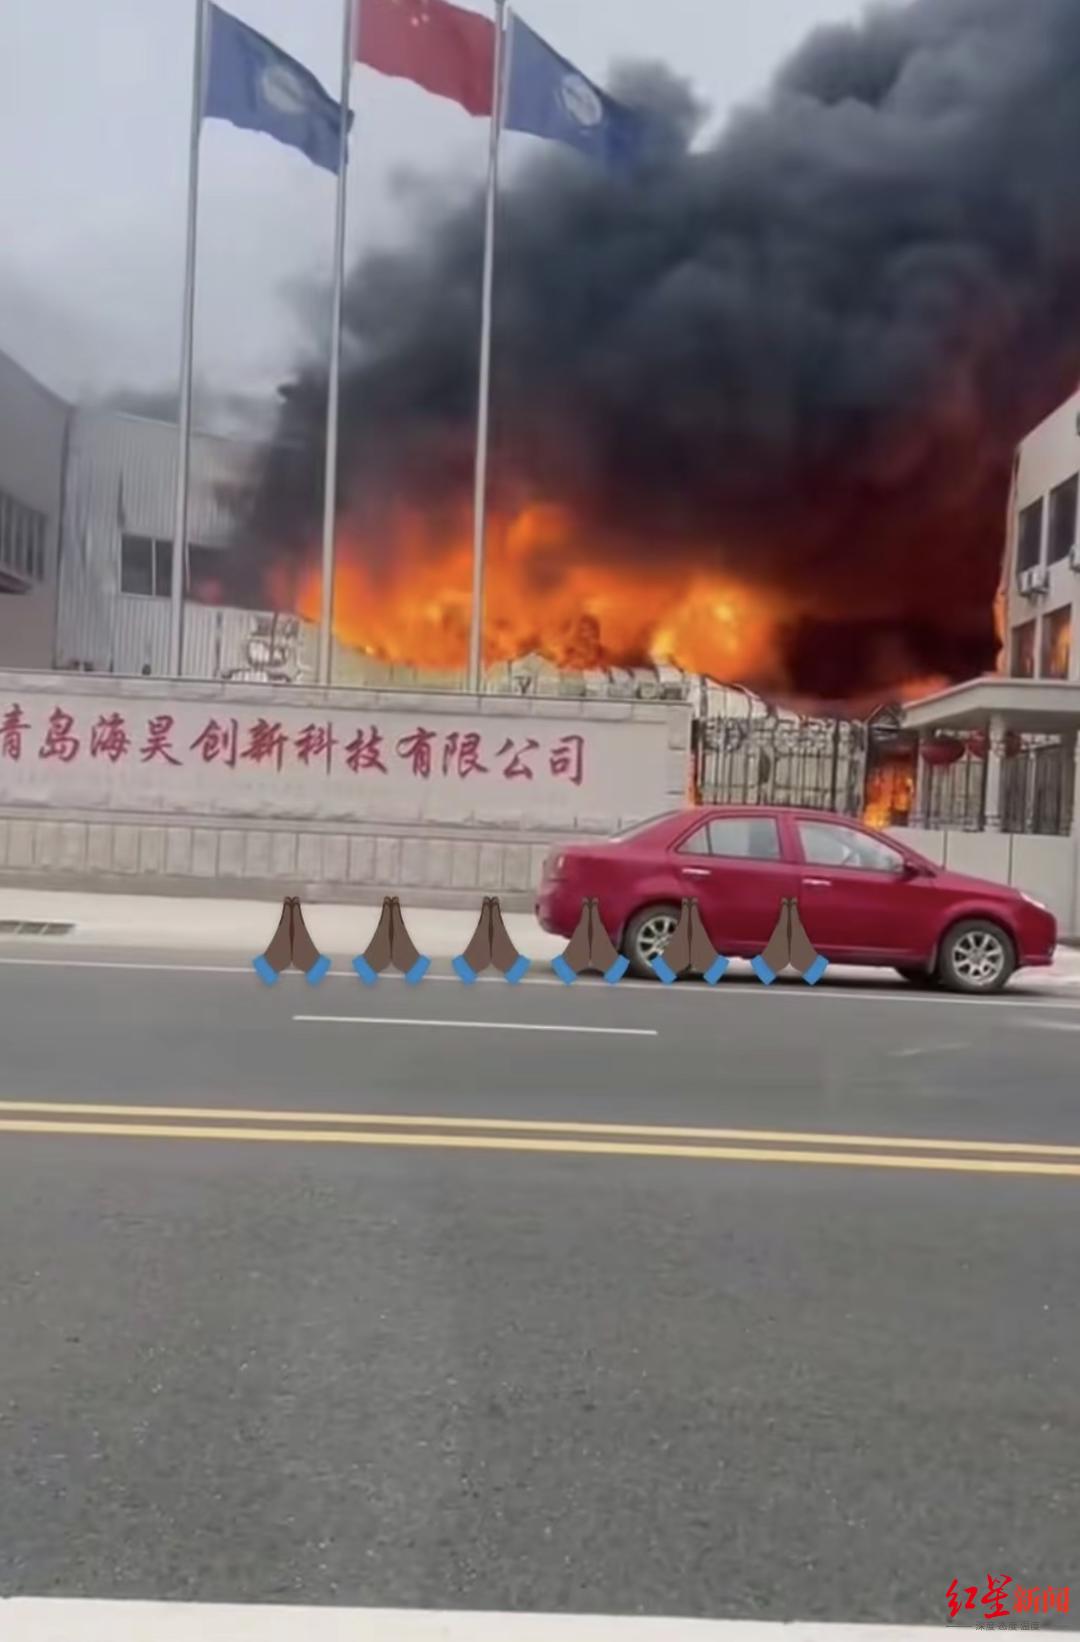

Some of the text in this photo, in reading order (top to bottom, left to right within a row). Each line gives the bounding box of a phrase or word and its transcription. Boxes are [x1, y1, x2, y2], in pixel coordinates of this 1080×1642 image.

[0, 703, 585, 785] 青岛海昊创新科技有限公司
